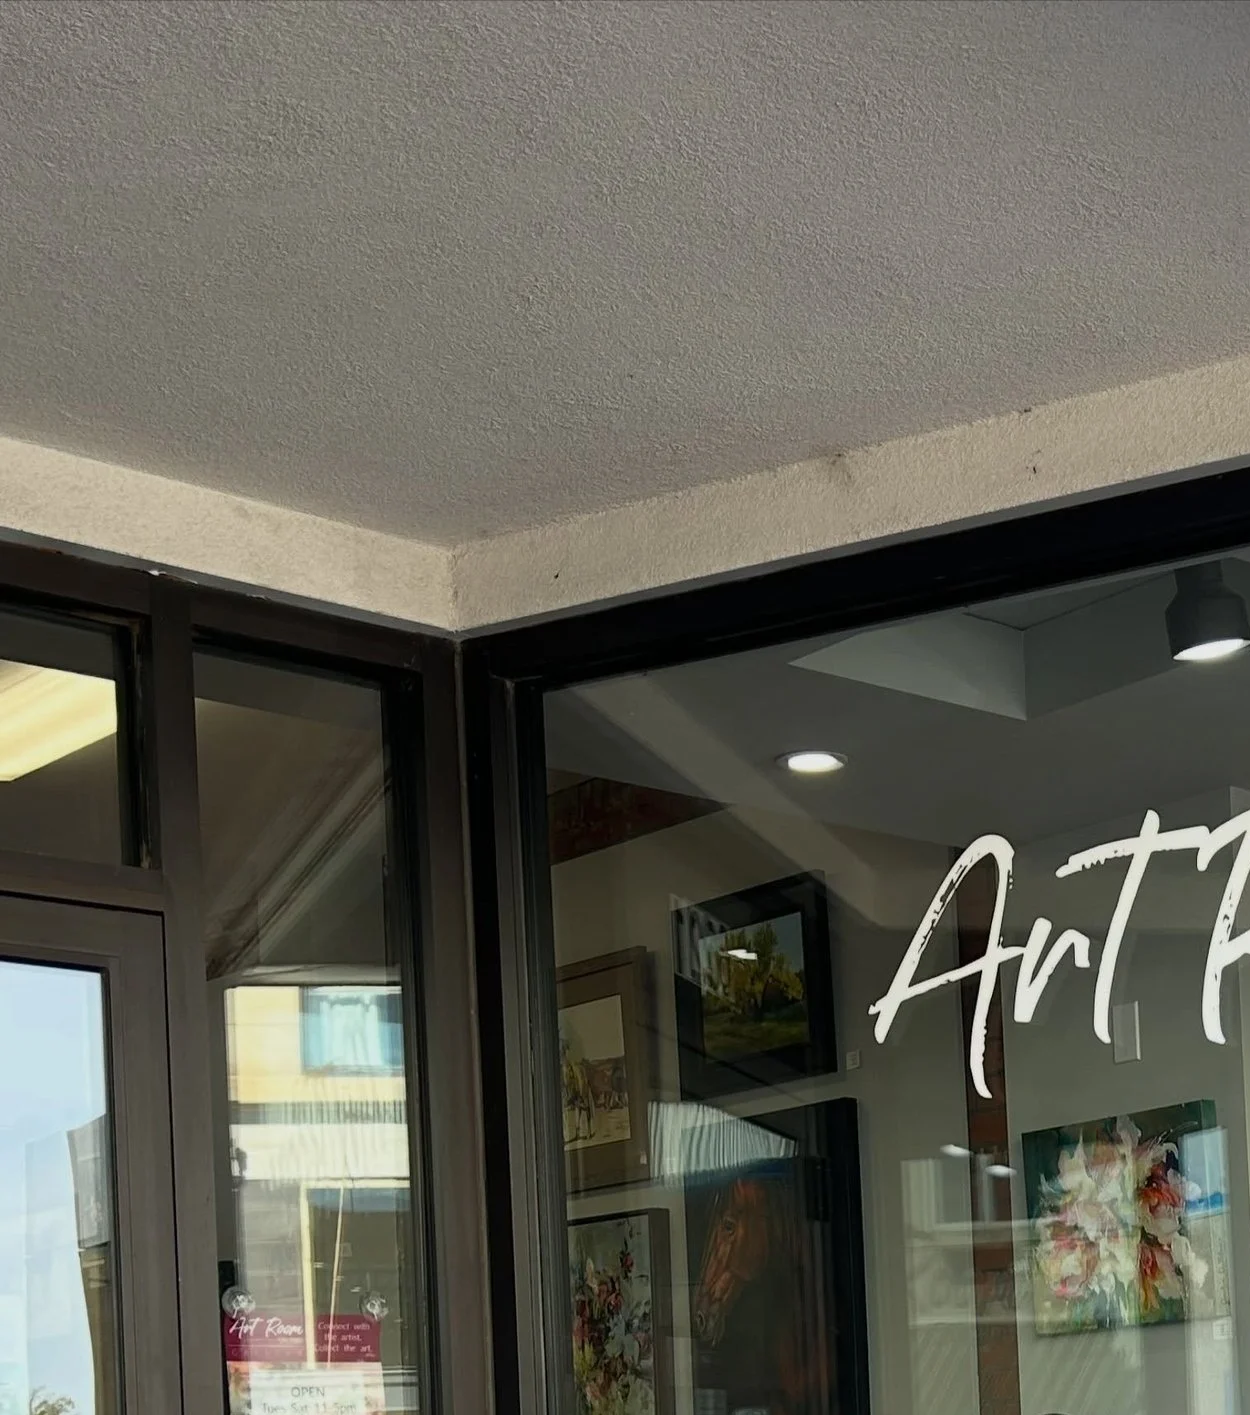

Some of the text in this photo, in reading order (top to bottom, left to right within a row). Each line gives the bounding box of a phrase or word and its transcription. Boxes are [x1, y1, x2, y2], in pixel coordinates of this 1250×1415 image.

[229, 1316, 304, 1339] Art Room
[291, 1386, 325, 1398] OPEN
